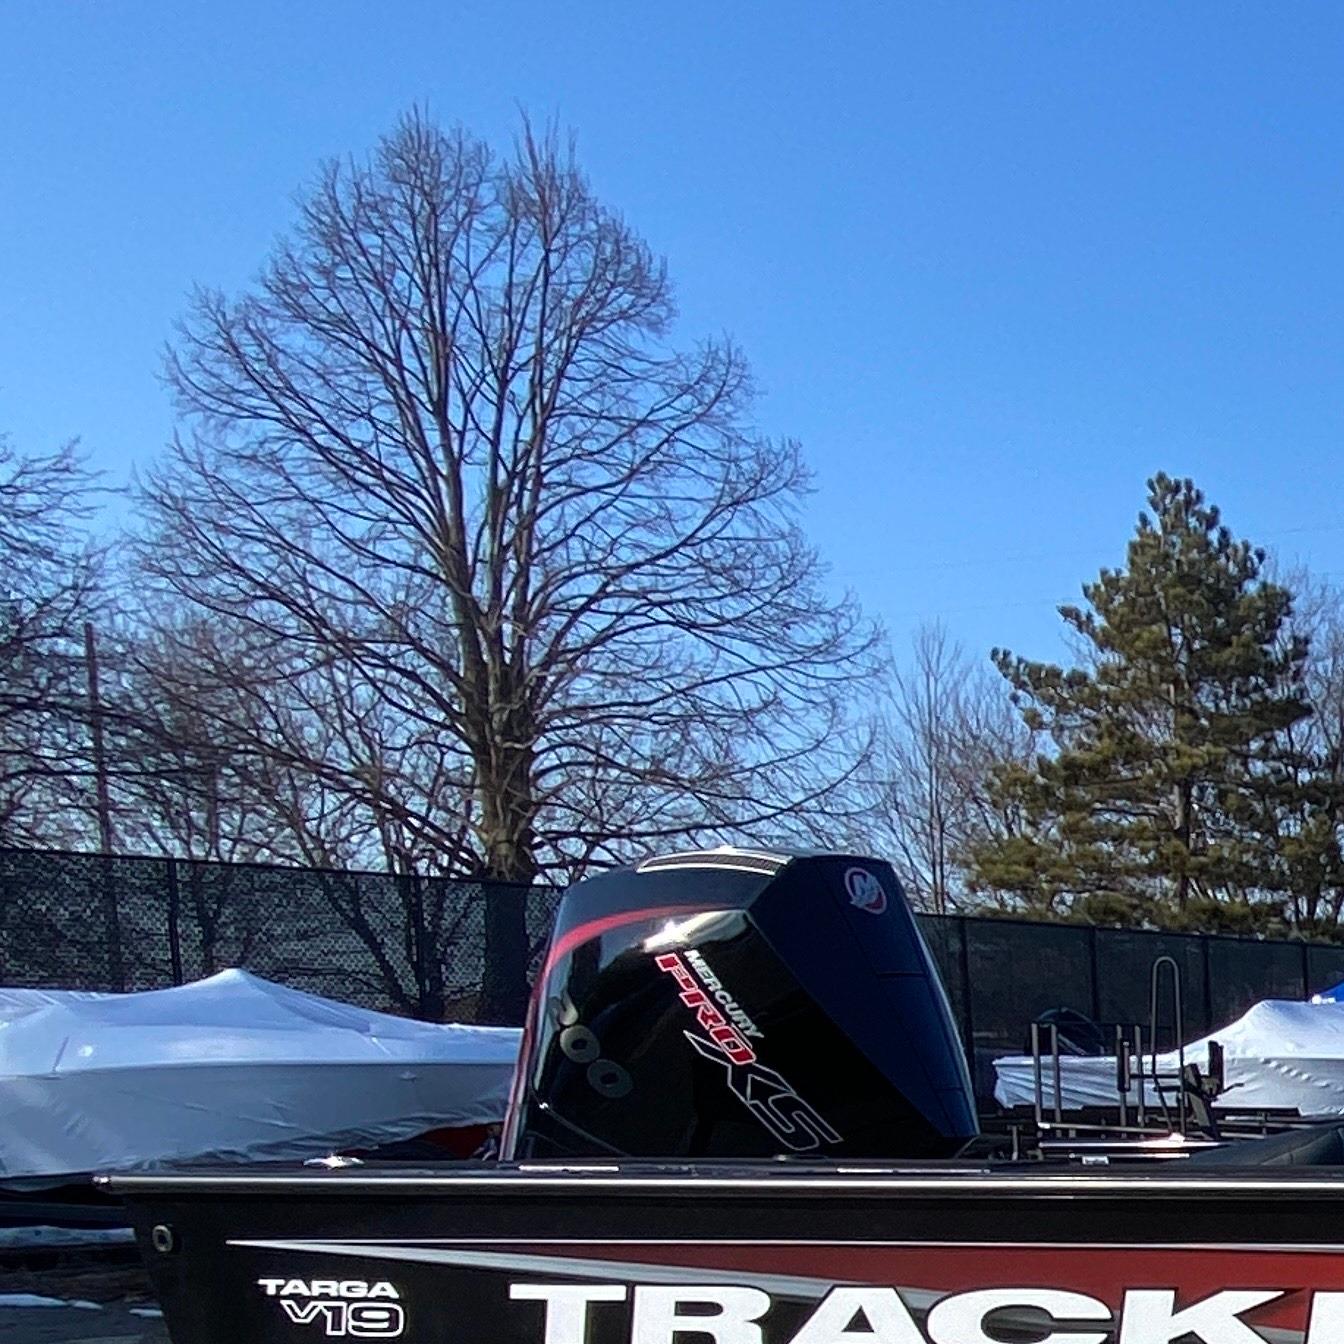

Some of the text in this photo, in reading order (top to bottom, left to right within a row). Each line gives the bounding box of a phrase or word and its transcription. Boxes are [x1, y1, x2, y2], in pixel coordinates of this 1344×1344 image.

[684, 949, 765, 1039] MERCURY
[655, 953, 844, 1151] PRO XS
[257, 1278, 400, 1299] TARGA
[279, 1299, 404, 1338] V19
